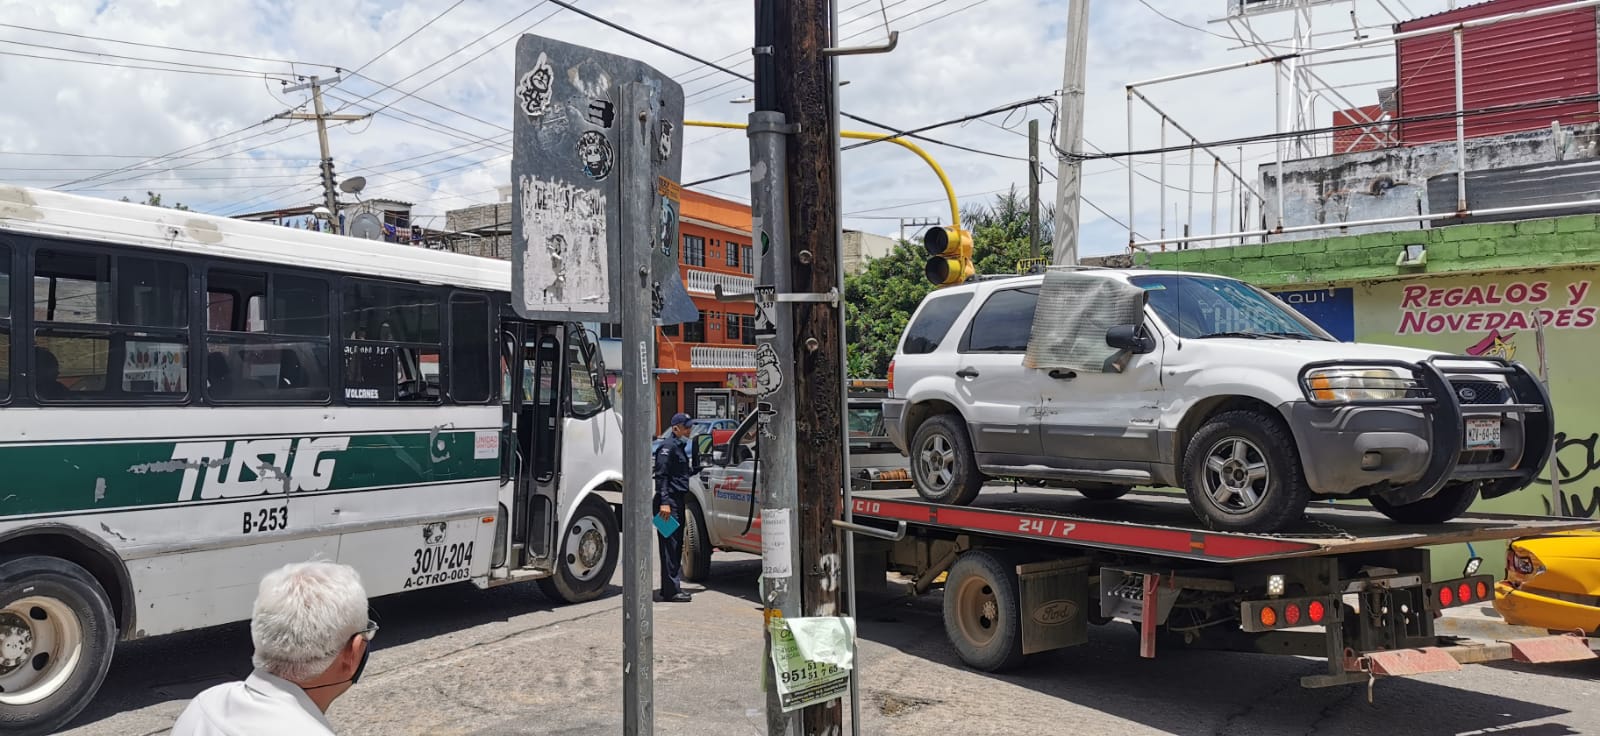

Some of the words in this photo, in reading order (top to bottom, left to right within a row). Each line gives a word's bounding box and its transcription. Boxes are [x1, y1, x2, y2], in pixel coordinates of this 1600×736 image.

[1400, 281, 1549, 309] REGALOS
[1397, 307, 1597, 334] NOVEDADES
[242, 506, 288, 534] B-253
[411, 540, 474, 575] 30/V-204
[403, 568, 470, 589] A-CTRO-003
